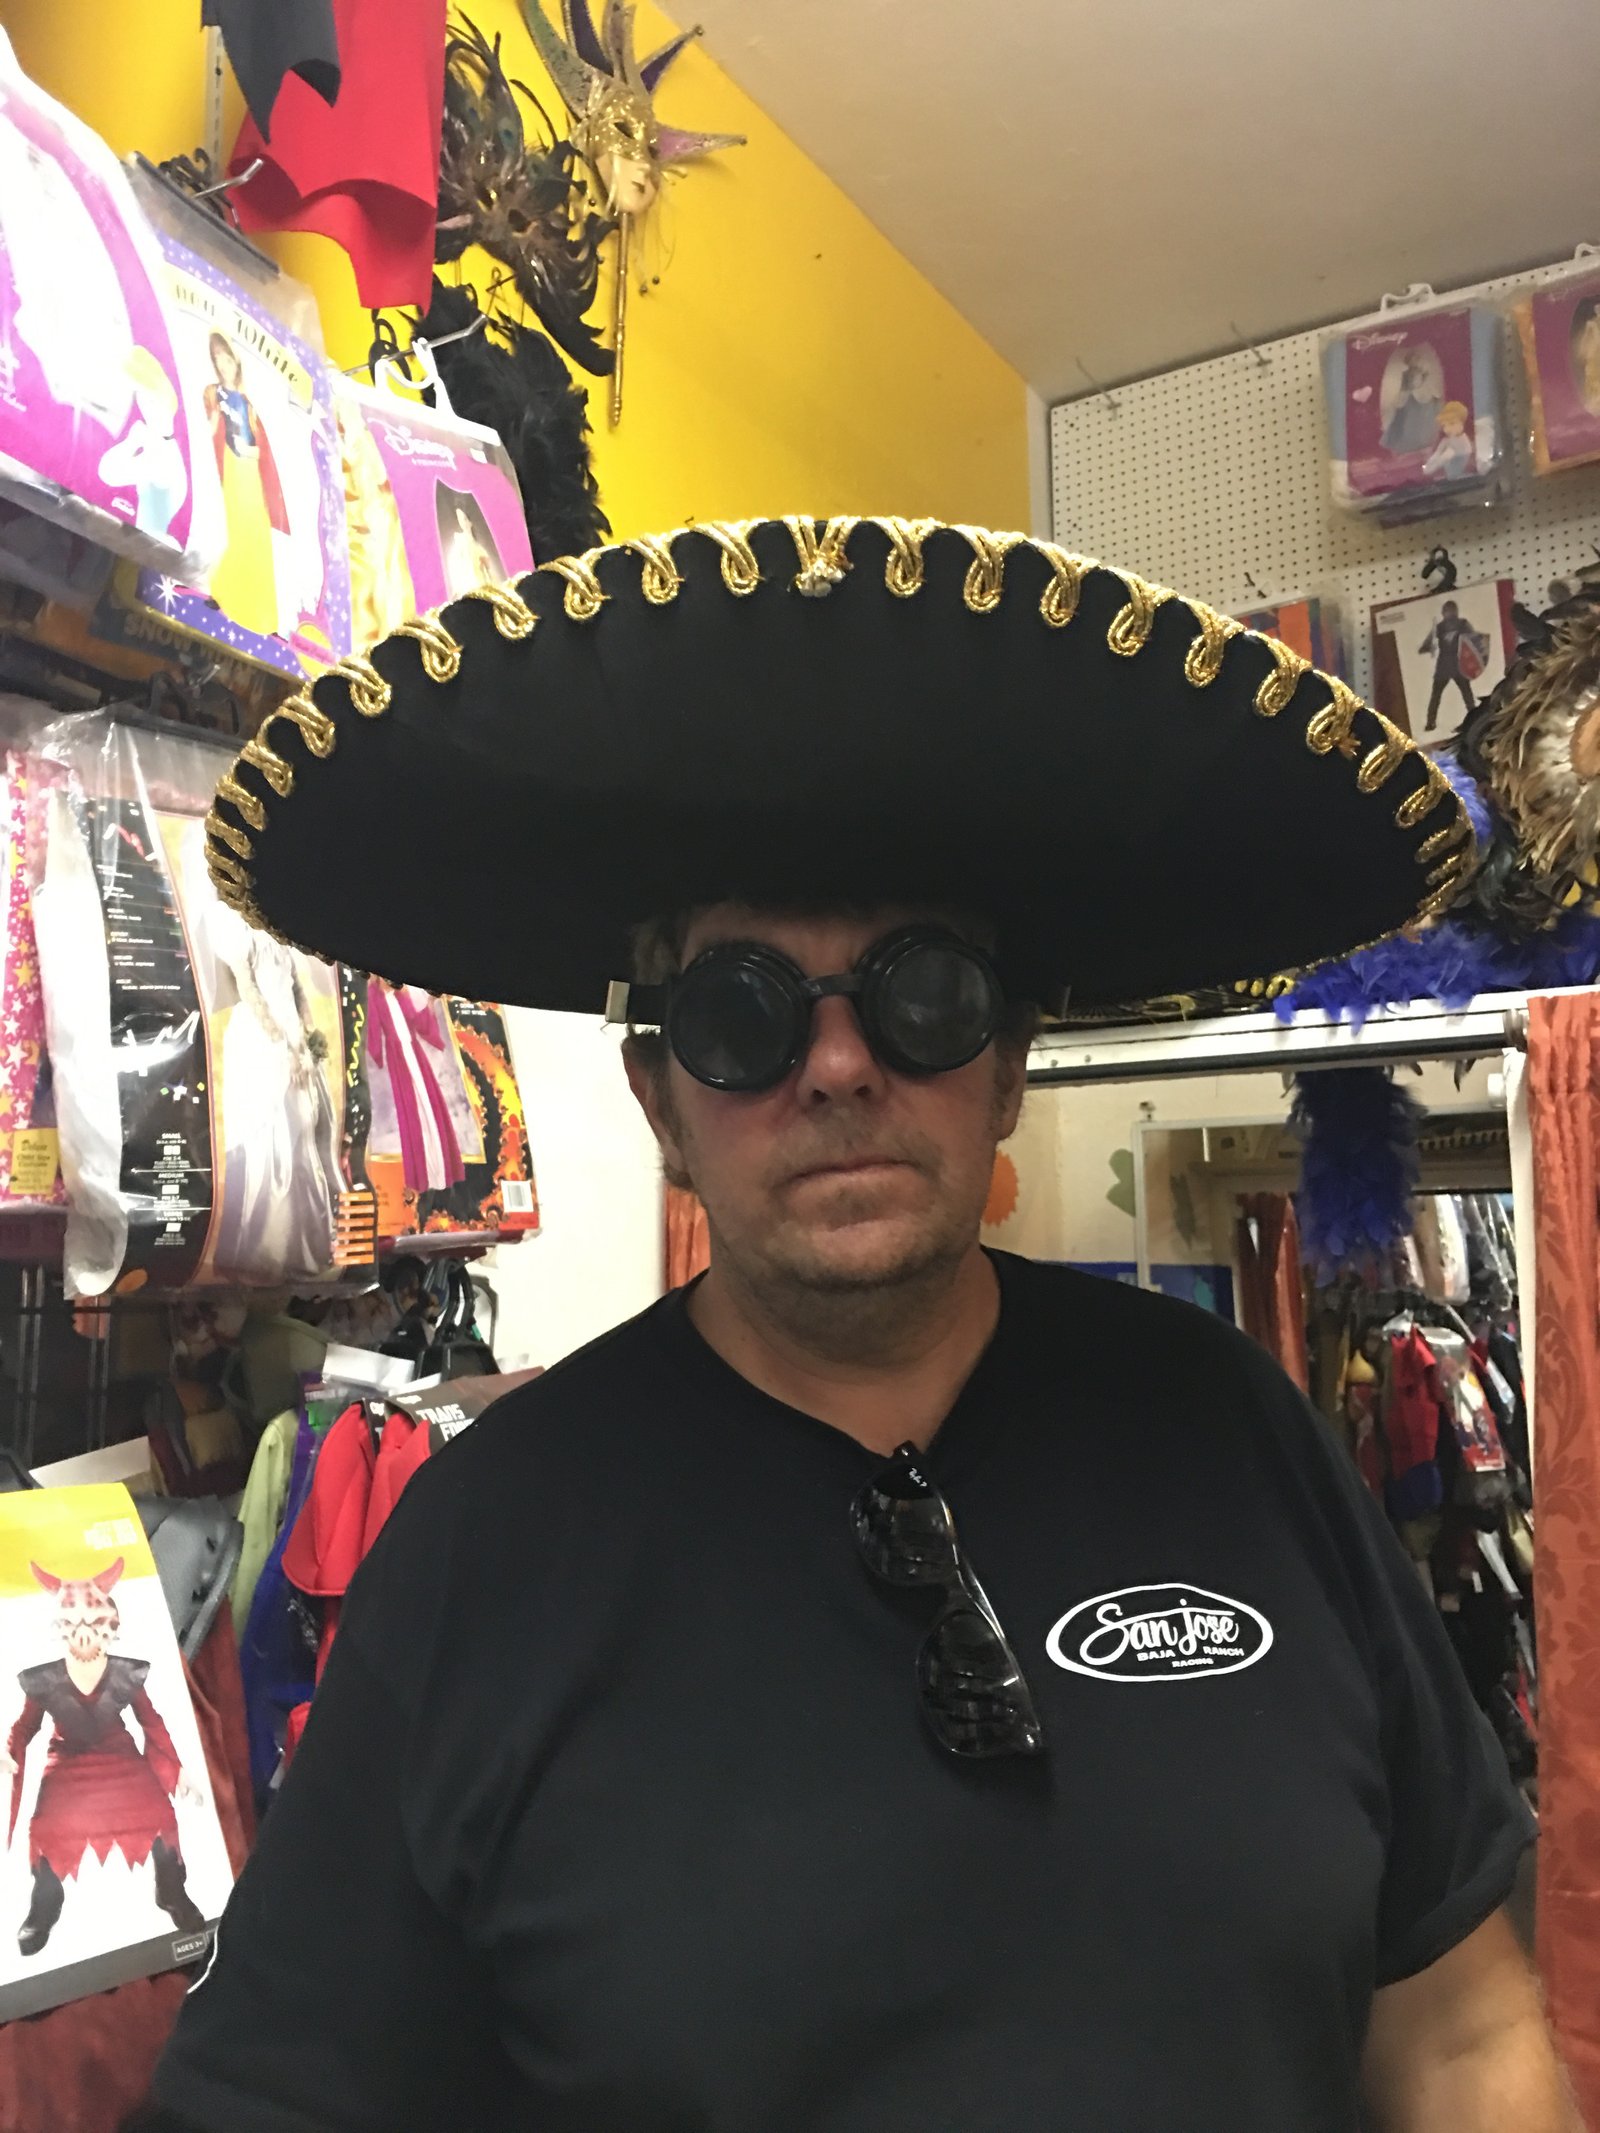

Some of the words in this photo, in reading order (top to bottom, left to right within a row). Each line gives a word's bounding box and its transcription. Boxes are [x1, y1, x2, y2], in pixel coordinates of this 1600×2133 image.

[1079, 1602, 1178, 1666] San
[1136, 1649, 1176, 1662] BAJA
[1202, 1645, 1245, 1657] RANCH
[1171, 1657, 1214, 1668] RACING
[176, 1943, 194, 1953] AGES
